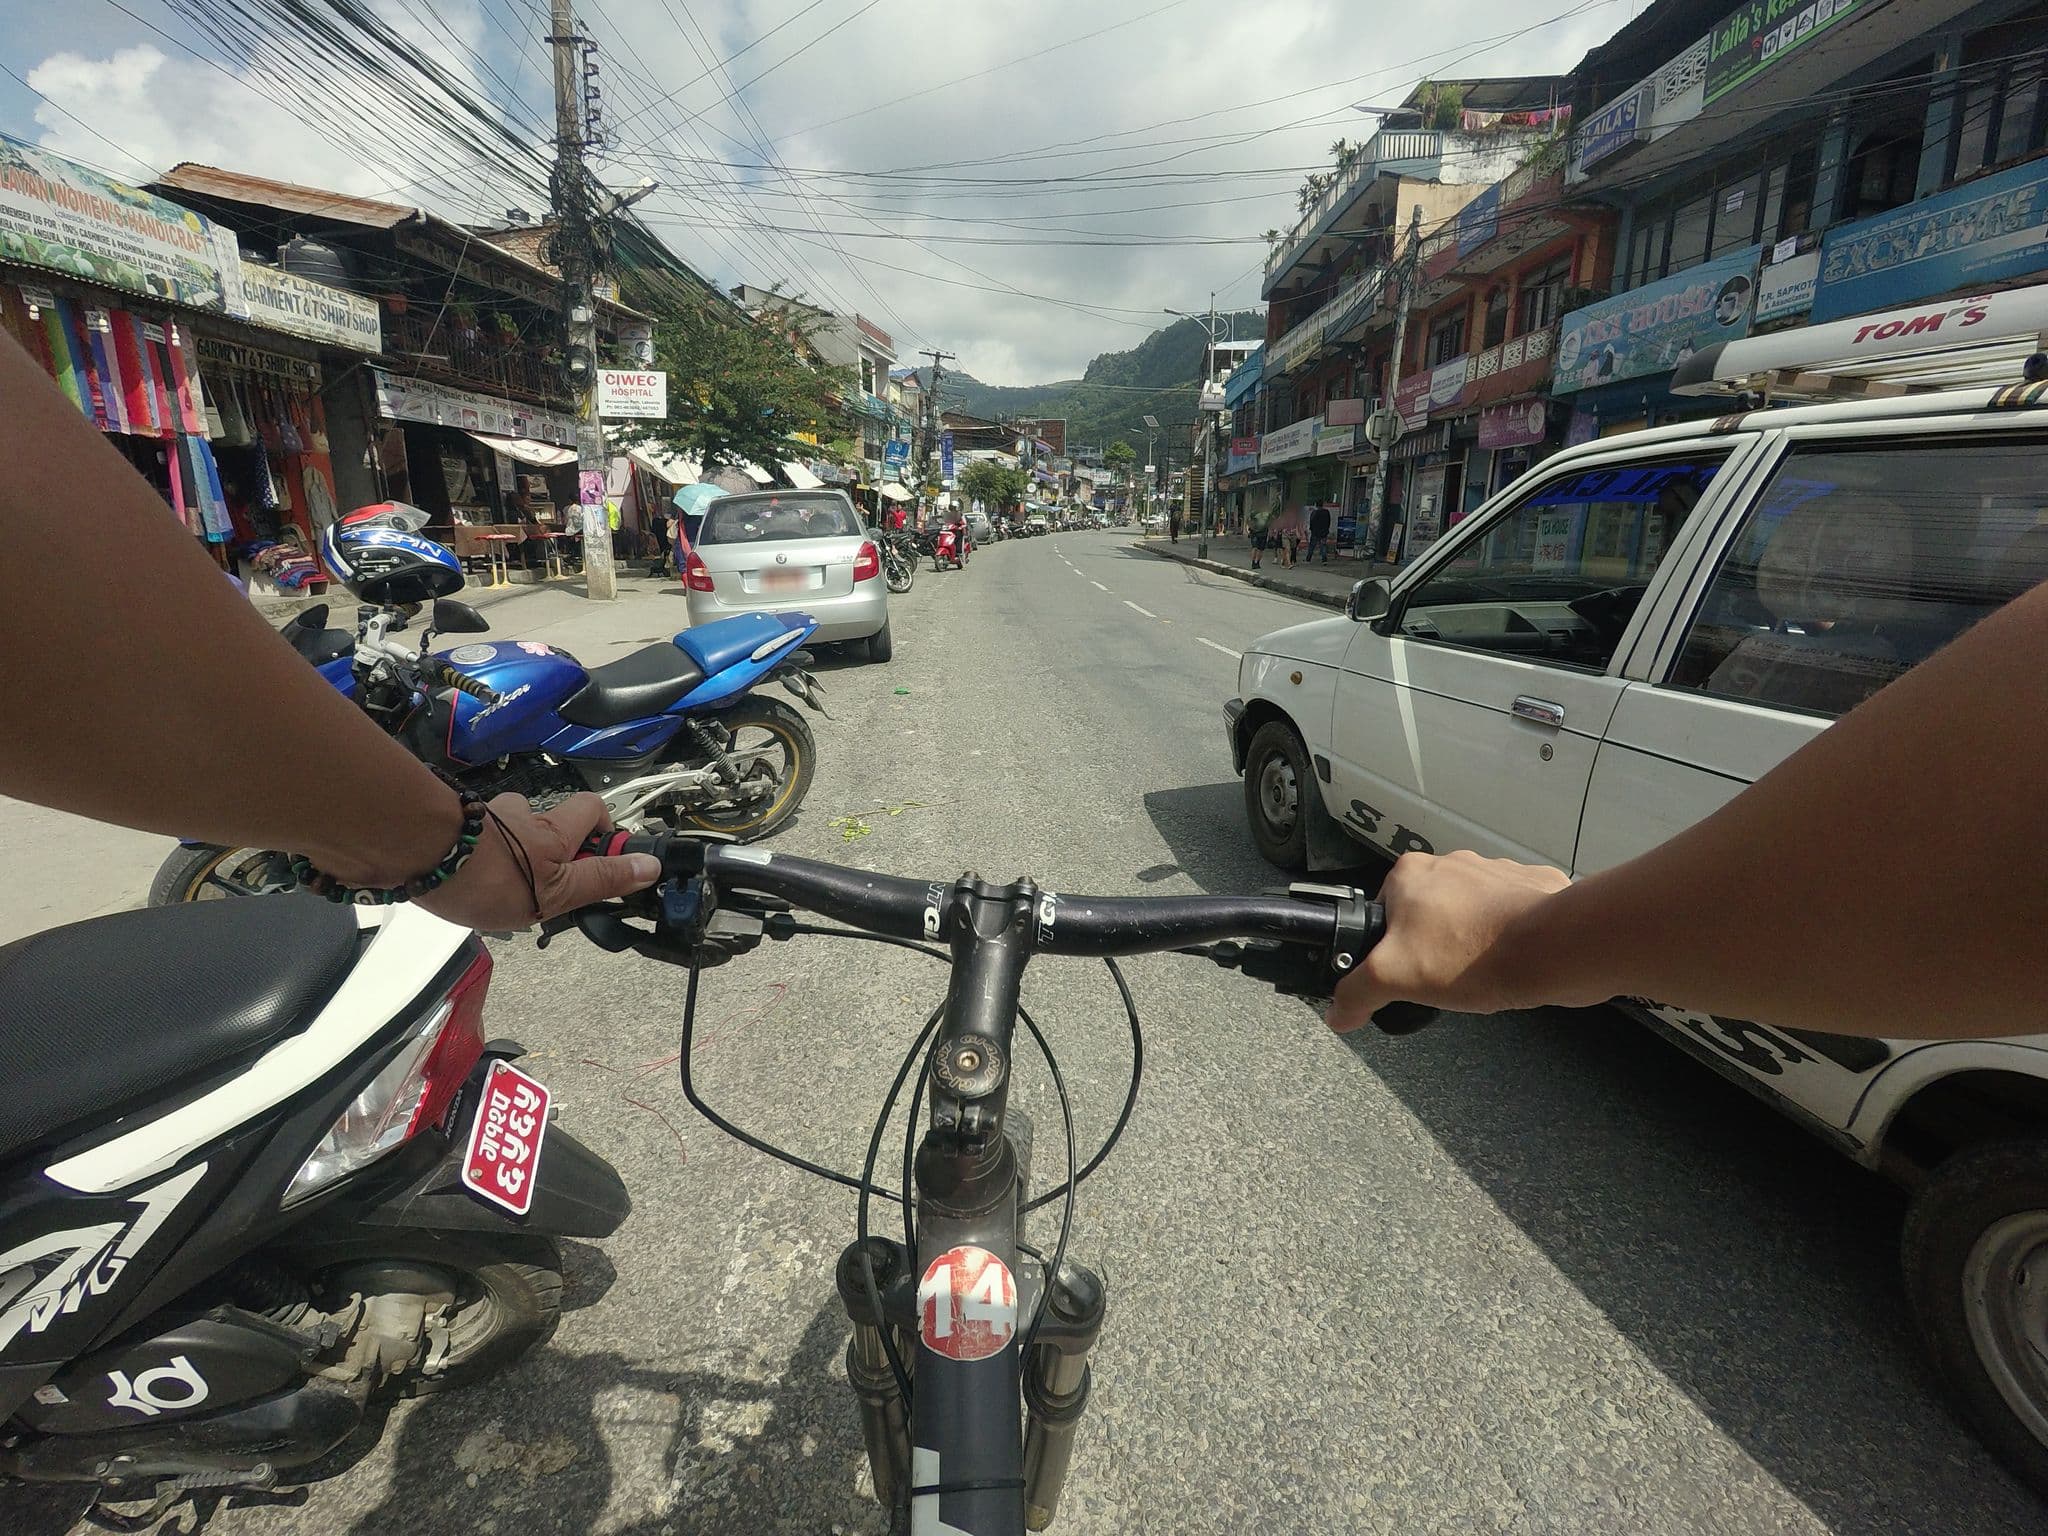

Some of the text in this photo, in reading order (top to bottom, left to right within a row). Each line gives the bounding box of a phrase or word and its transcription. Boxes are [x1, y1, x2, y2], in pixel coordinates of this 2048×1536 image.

[1709, 3, 1762, 63] Laila's
[1583, 98, 1636, 149] LAILA'S
[51, 181, 124, 229] WOMEN'S
[125, 208, 209, 258] HANDICRAFT
[242, 280, 301, 315] GARMENT
[352, 313, 378, 336] SHOP
[291, 279, 350, 307] LAKES
[1852, 305, 1989, 345] TOM'S
[605, 373, 657, 387] CIWEC
[611, 388, 653, 397] HOSPITAL
[379, 532, 443, 558] SPIN
[1552, 518, 1570, 535] HOUSE
[920, 1262, 1016, 1340] 14
